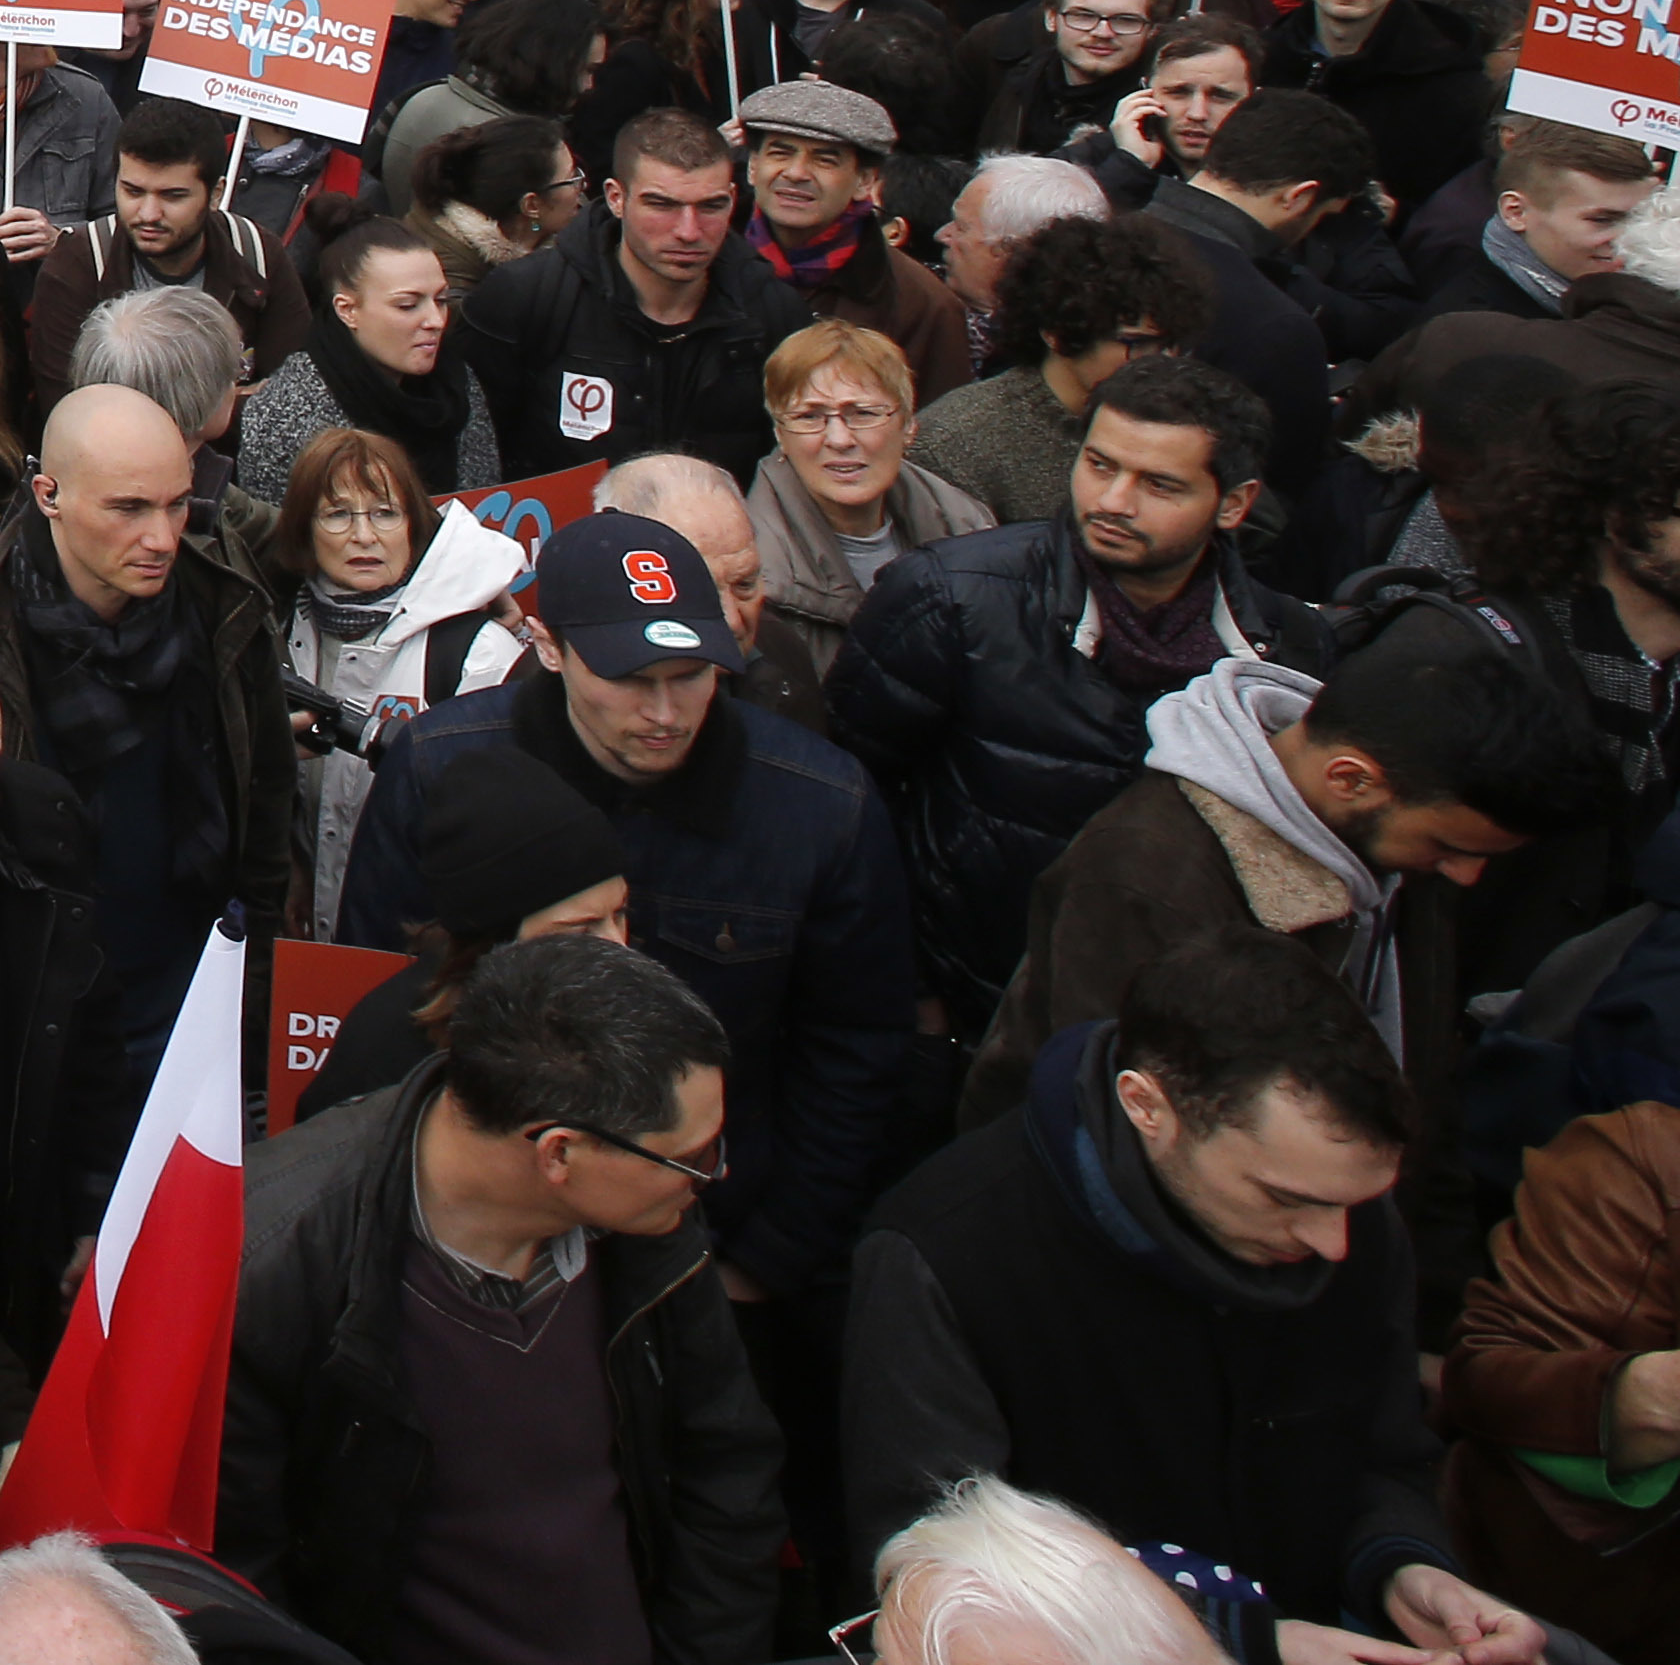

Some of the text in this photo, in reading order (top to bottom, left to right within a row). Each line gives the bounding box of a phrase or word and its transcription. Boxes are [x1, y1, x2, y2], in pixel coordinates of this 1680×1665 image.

[162, 6, 372, 75] DES MÉDIAS
[1533, 5, 1626, 47] DES
[225, 82, 298, 110] Mélenchon
[622, 550, 676, 604] S
